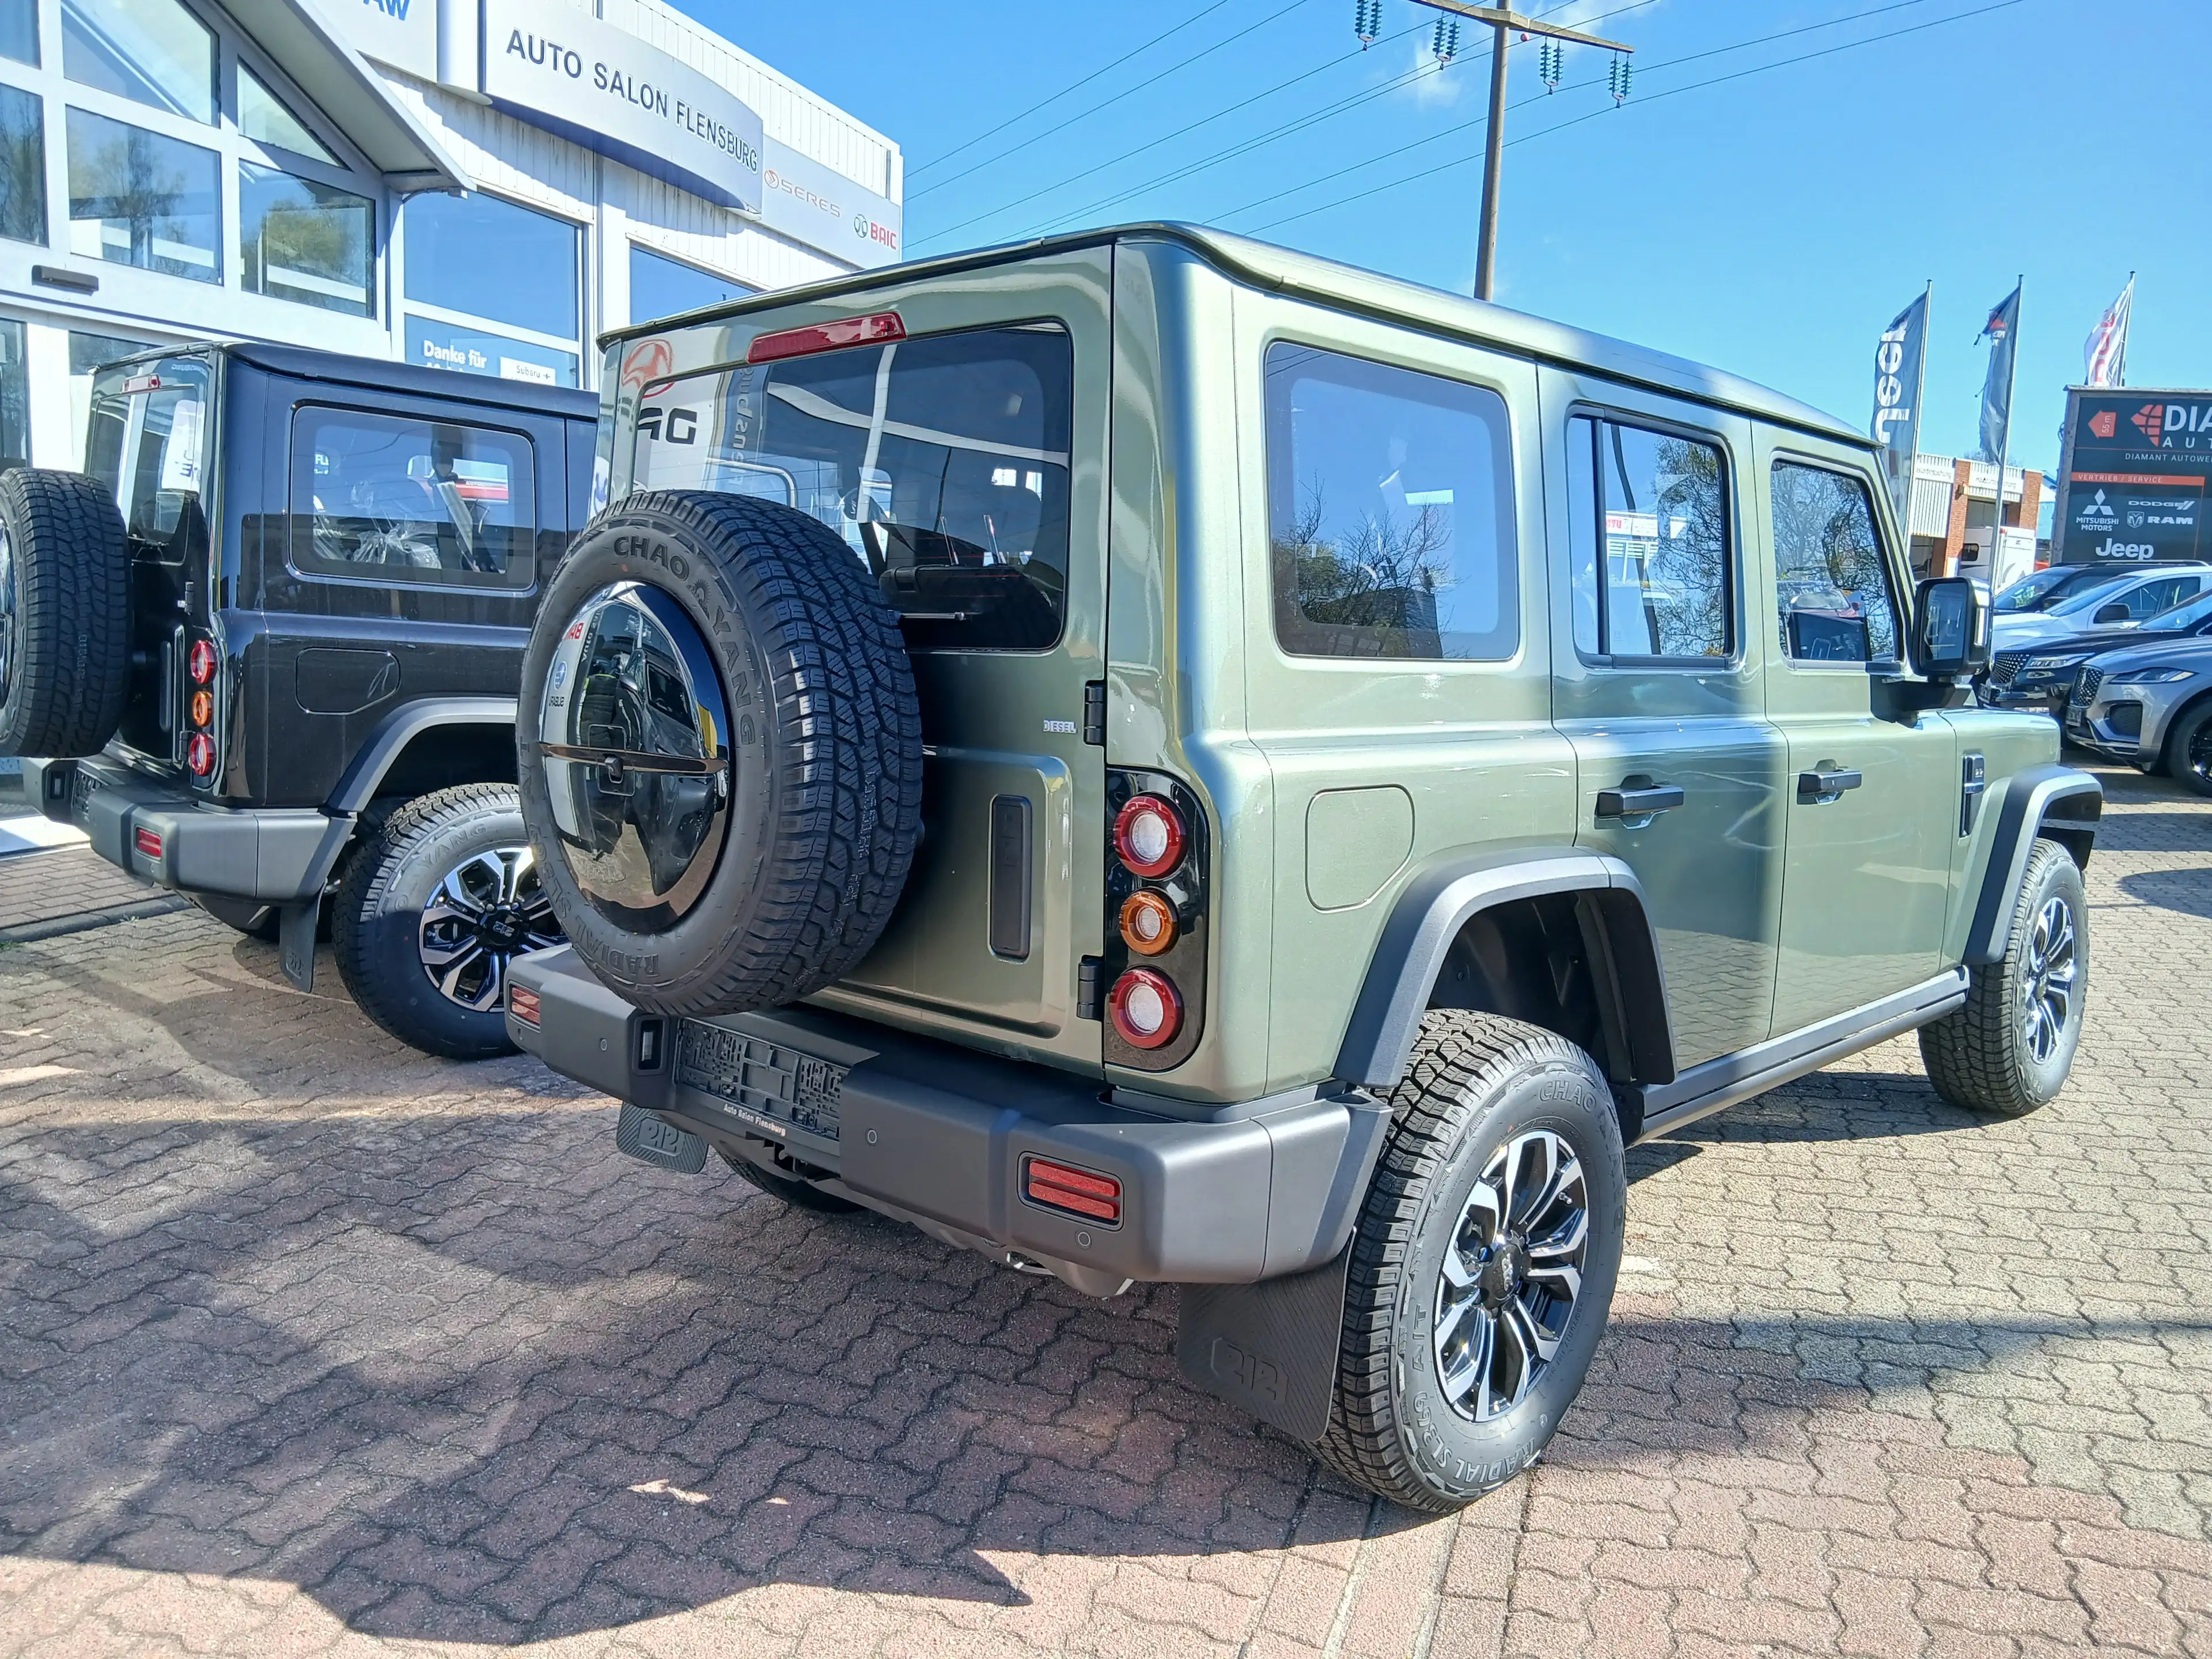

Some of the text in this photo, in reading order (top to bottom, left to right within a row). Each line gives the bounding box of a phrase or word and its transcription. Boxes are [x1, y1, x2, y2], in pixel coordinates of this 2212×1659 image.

[506, 29, 758, 172] AUTO SALON FLENSBURG
[781, 179, 840, 218] SERES
[870, 221, 897, 250] BAIC
[423, 340, 465, 363] Danke
[468, 349, 488, 369] für
[516, 364, 540, 378] Subaru
[2125, 453, 2212, 463] DIAMANT AUTOWE
[2078, 474, 2118, 482] VERTRIEB
[2127, 475, 2163, 483] SERVICE
[2128, 501, 2182, 509] DODGE
[2075, 517, 2119, 525] MITSUBISHI
[2147, 516, 2193, 525] RAM
[2095, 538, 2154, 560] Jeep
[613, 540, 756, 745] CHAO YANG
[1043, 719, 1077, 734] DIESEL
[575, 914, 659, 978] RADIAL
[1539, 1080, 1597, 1113] CHAO
[724, 1103, 786, 1137] Auto Salon Flensburg
[1453, 1438, 1536, 1484] RADIAL
